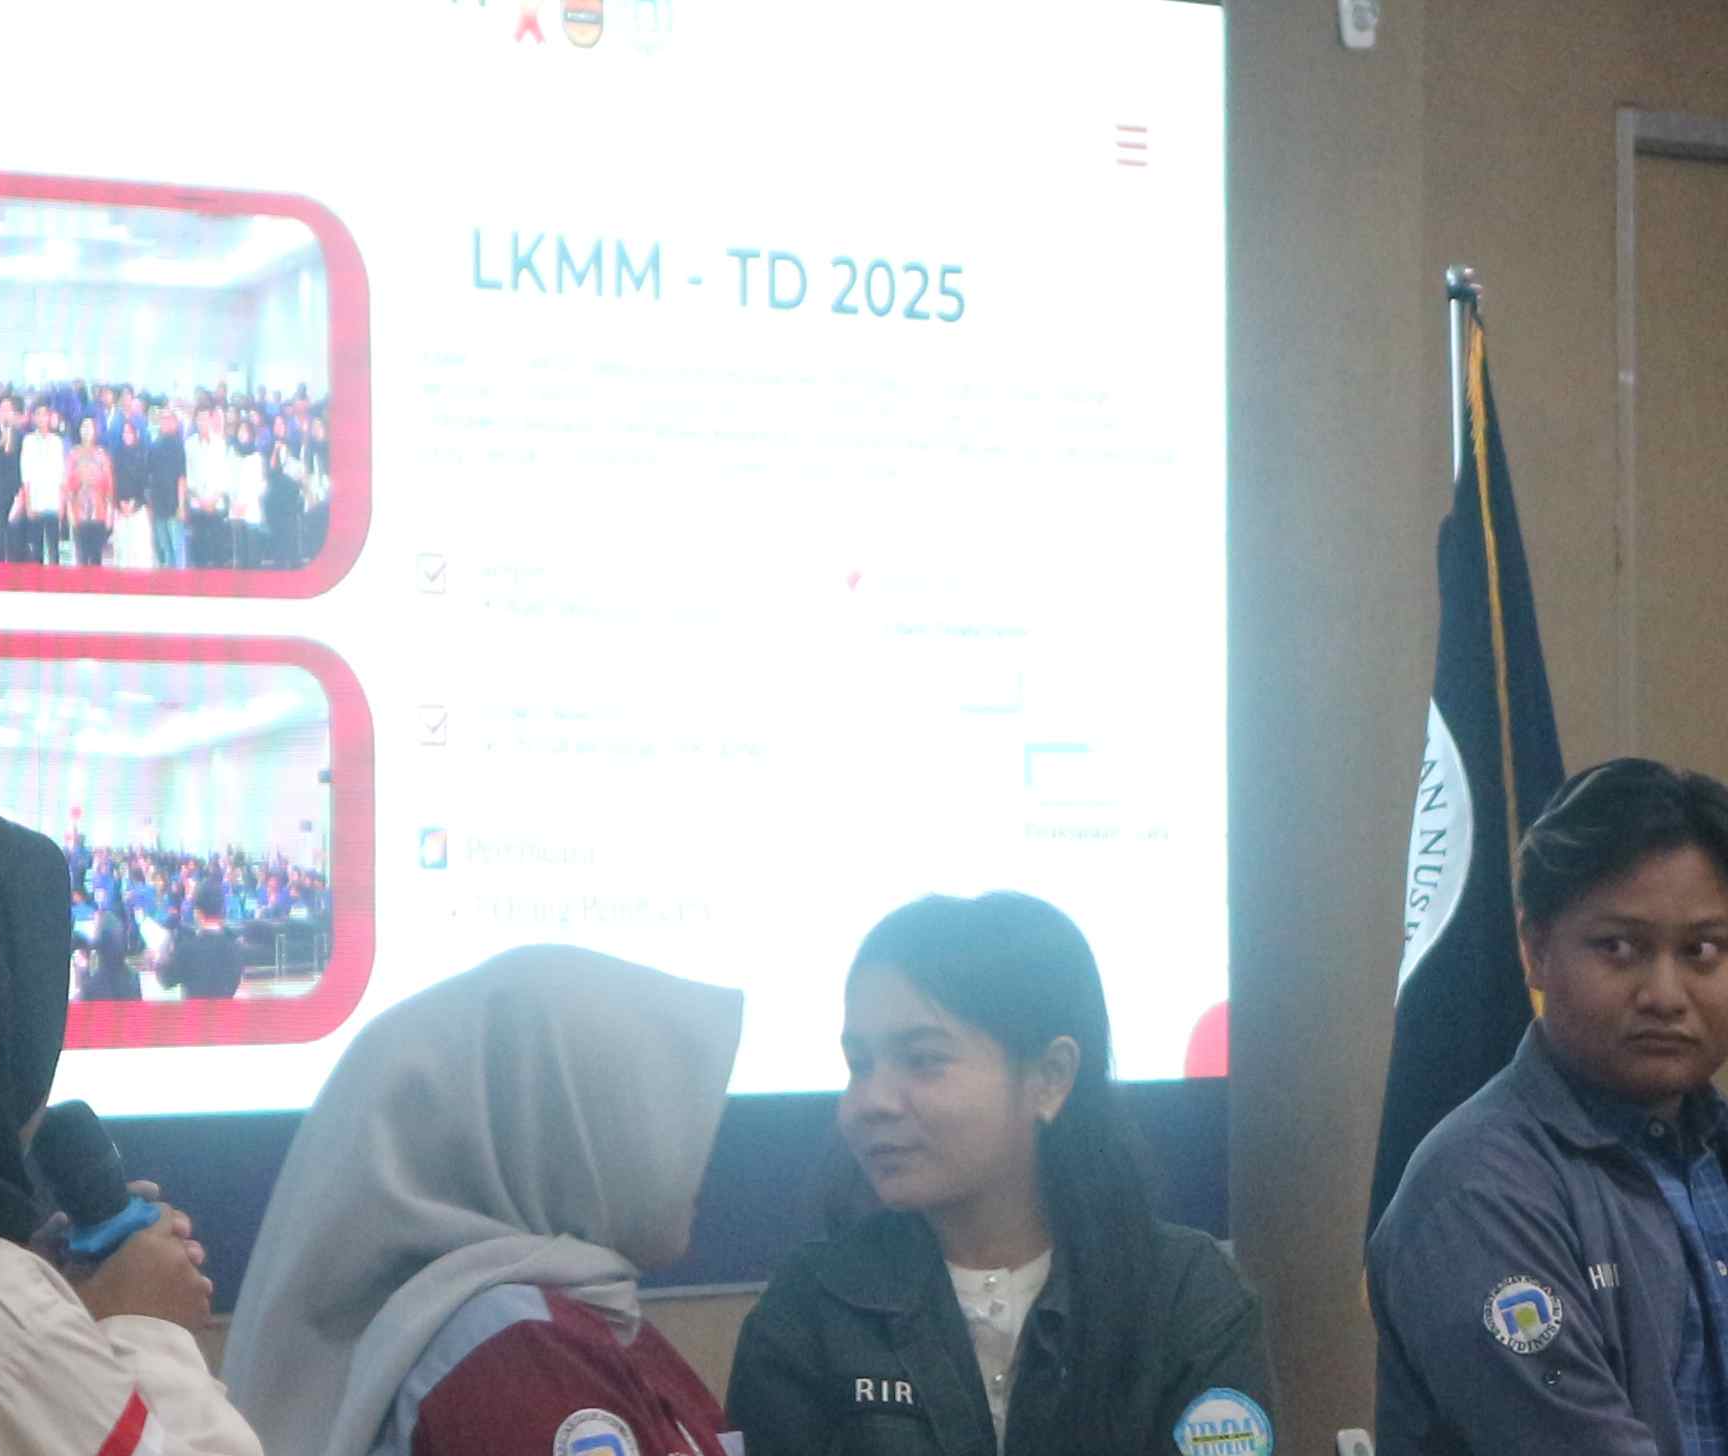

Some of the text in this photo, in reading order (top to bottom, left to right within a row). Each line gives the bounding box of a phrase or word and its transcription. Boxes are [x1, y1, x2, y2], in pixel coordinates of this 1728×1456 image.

[472, 227, 662, 301] LKMM
[726, 247, 808, 311] TD
[829, 254, 967, 324] 2025
